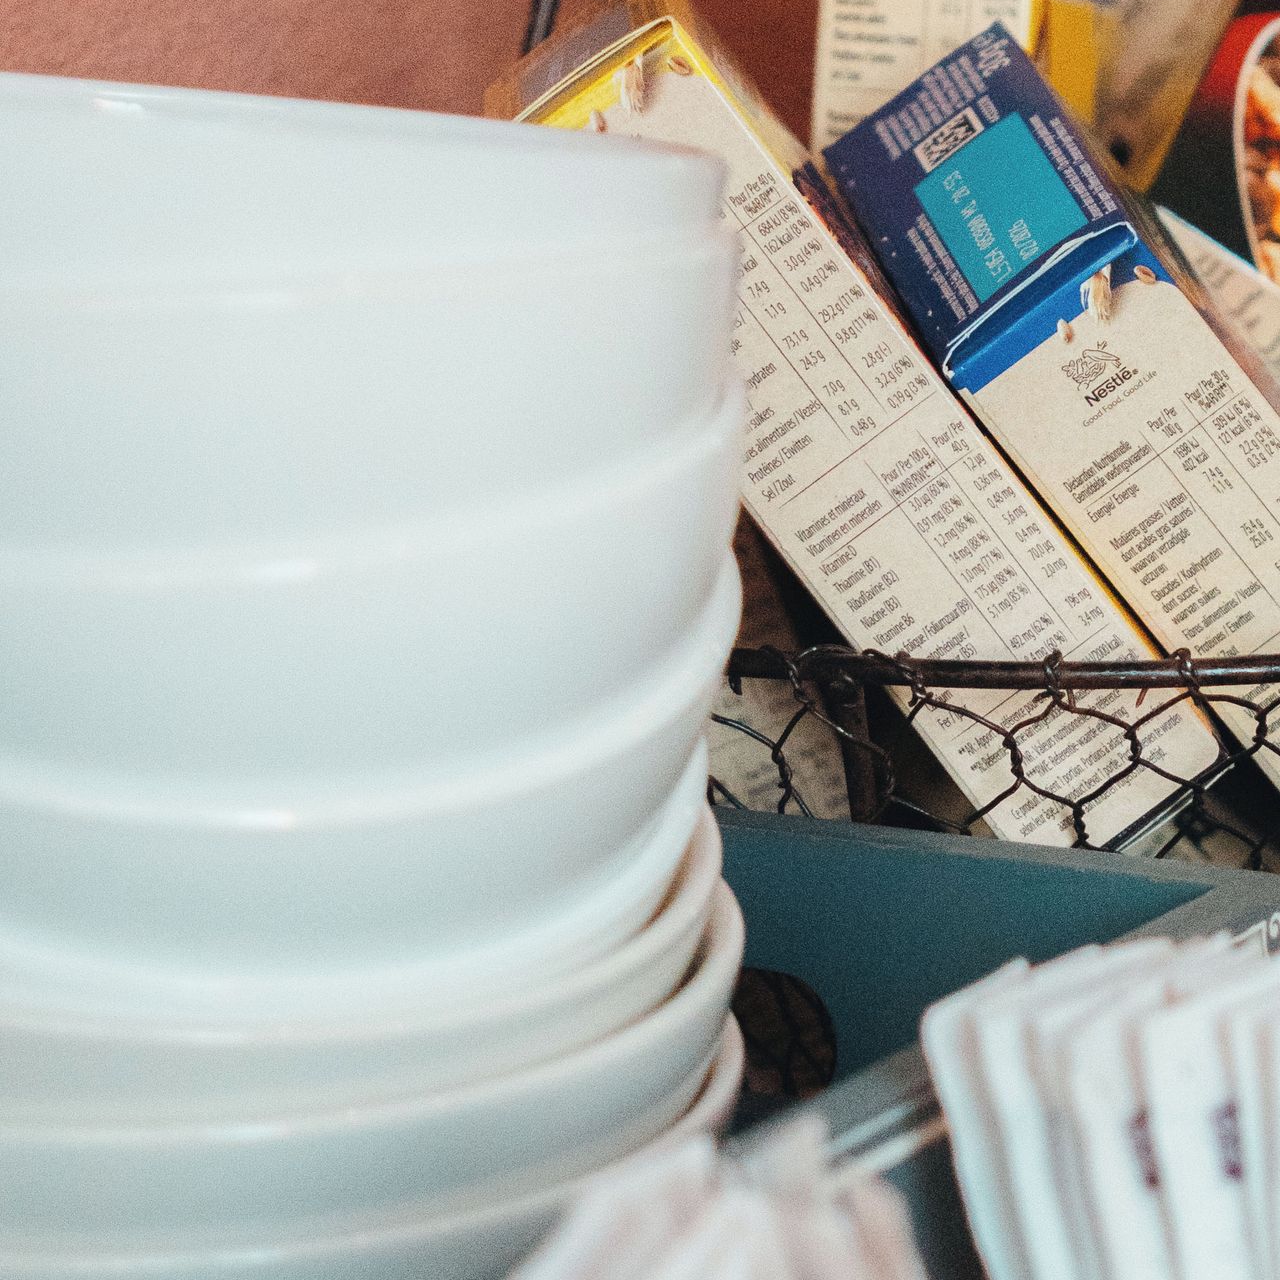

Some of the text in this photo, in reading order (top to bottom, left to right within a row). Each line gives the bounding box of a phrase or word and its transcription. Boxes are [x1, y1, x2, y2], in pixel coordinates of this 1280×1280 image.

[728, 191, 747, 207] Pour
[745, 181, 761, 195] Per
[775, 227, 794, 246] kcal
[740, 254, 758, 272] kcal
[1082, 409, 1103, 427] Good
[1122, 378, 1143, 397] Good
[1142, 370, 1157, 382] Life
[1183, 388, 1202, 403] Pour
[1200, 378, 1215, 390] Per
[749, 406, 775, 428] suikers
[754, 399, 821, 452] alimentaires Vezels
[1146, 406, 1177, 432] Pour Per
[1228, 419, 1246, 437] kcal
[780, 434, 813, 459] Eiwitten
[931, 420, 965, 448] Pour Per
[1191, 447, 1209, 464] kcal
[880, 458, 912, 484] Pour Per
[761, 473, 796, 502] Sel Zout
[1111, 482, 1139, 504] Energie
[1137, 509, 1164, 533] grasses
[1162, 491, 1187, 511] Vetten
[794, 514, 830, 542] Vitamines
[805, 528, 842, 557] Vitaminen
[848, 499, 882, 528] mineralen
[1120, 546, 1138, 562] dont
[1135, 531, 1157, 552] acides
[1154, 522, 1171, 540] gras
[818, 551, 852, 576] Vitamine
[1129, 527, 1190, 574] waarvan verzadigde
[832, 555, 881, 593] Thiamine (B1)
[1139, 563, 1168, 586] vetzuren
[1150, 547, 1223, 601] Glucides Koolhydraten
[846, 569, 899, 612] Riboflavine (B2)
[1161, 583, 1198, 613] dont sucres
[859, 594, 901, 629] Niacine (B3)
[1171, 586, 1221, 625] waarvan suikers
[1181, 581, 1261, 640] Fibres alimentaires Vezels
[872, 612, 915, 646] Vitamine B6
[902, 597, 973, 653] folique Foliumzuur (B9)
[1225, 610, 1255, 633] Eiwitten
